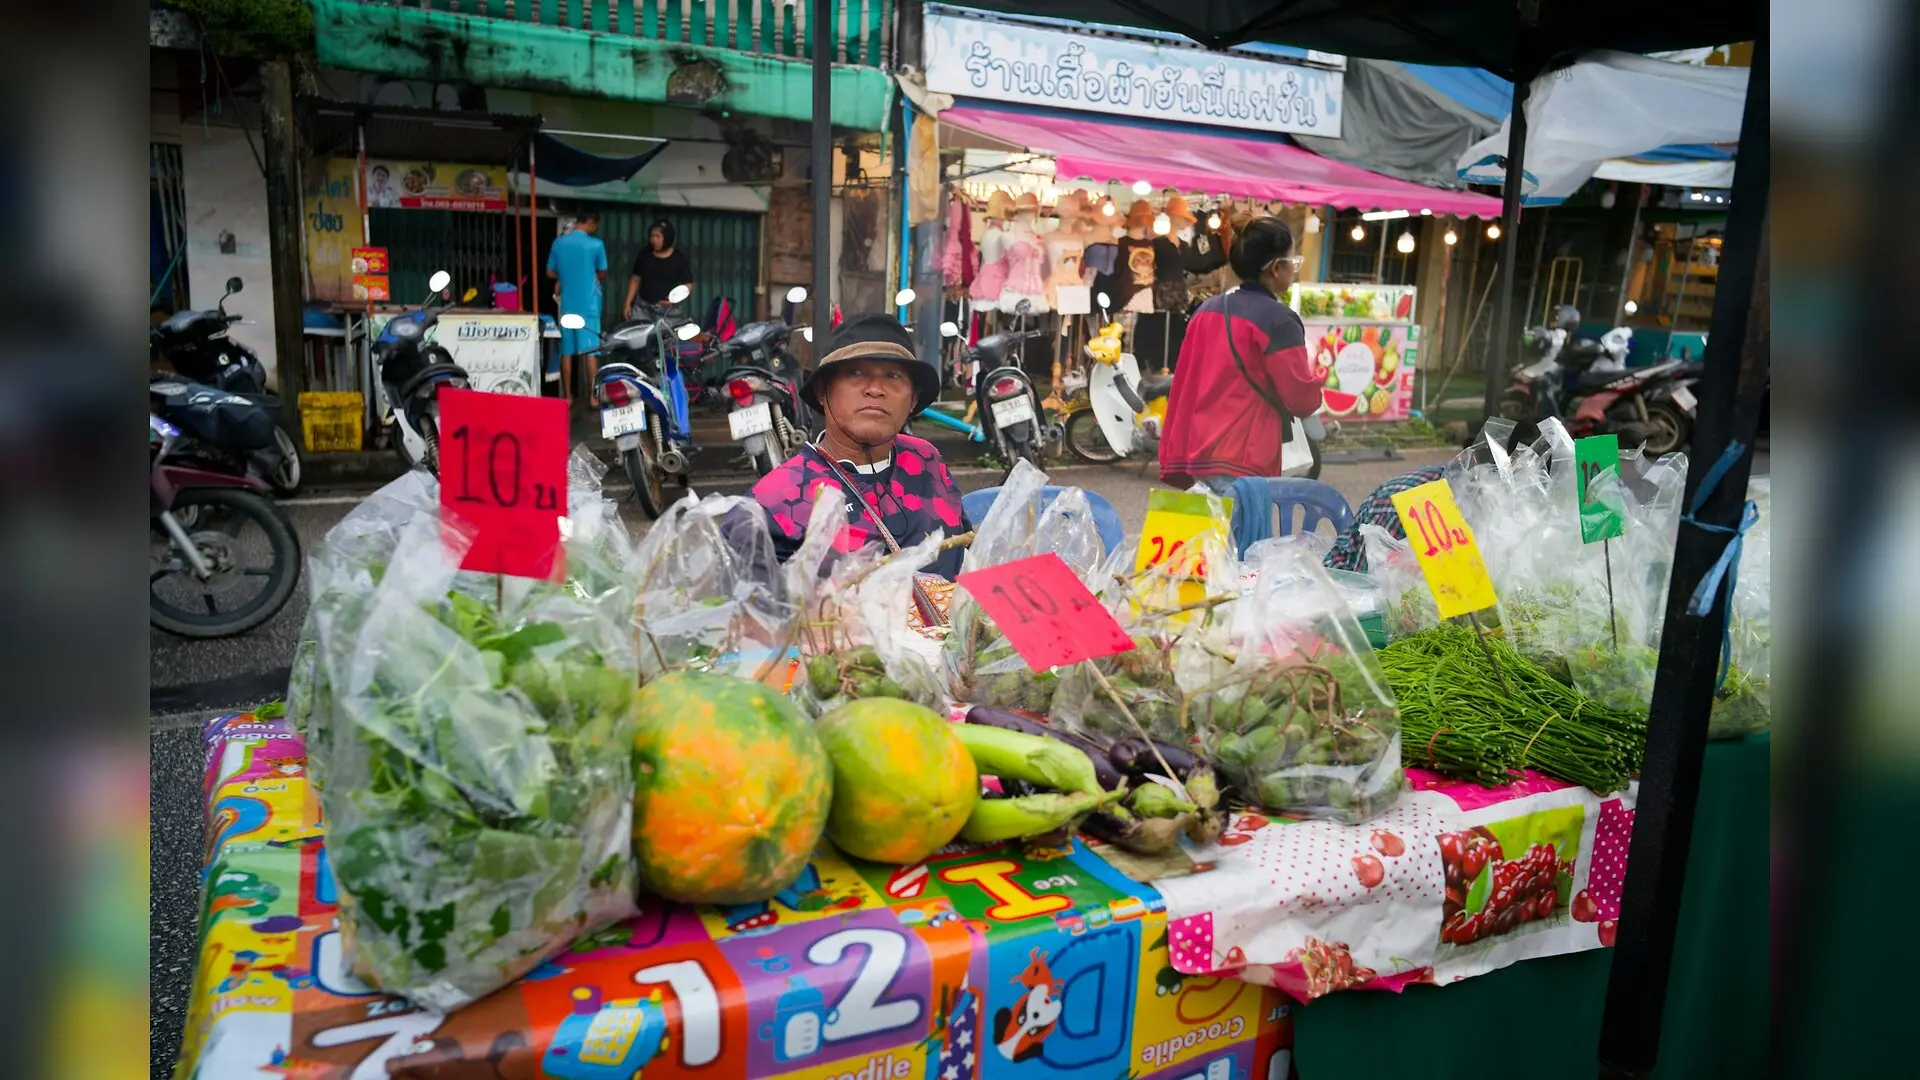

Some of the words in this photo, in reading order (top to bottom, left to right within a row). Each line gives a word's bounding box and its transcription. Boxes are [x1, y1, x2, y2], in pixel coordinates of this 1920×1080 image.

[452, 424, 522, 508] 10
[991, 573, 1058, 623] 10
[938, 858, 1074, 921] I
[1033, 874, 1079, 890] Ice
[633, 958, 722, 1067] 1
[805, 927, 924, 1044] 2
[1141, 1016, 1245, 1066] Crocodile
